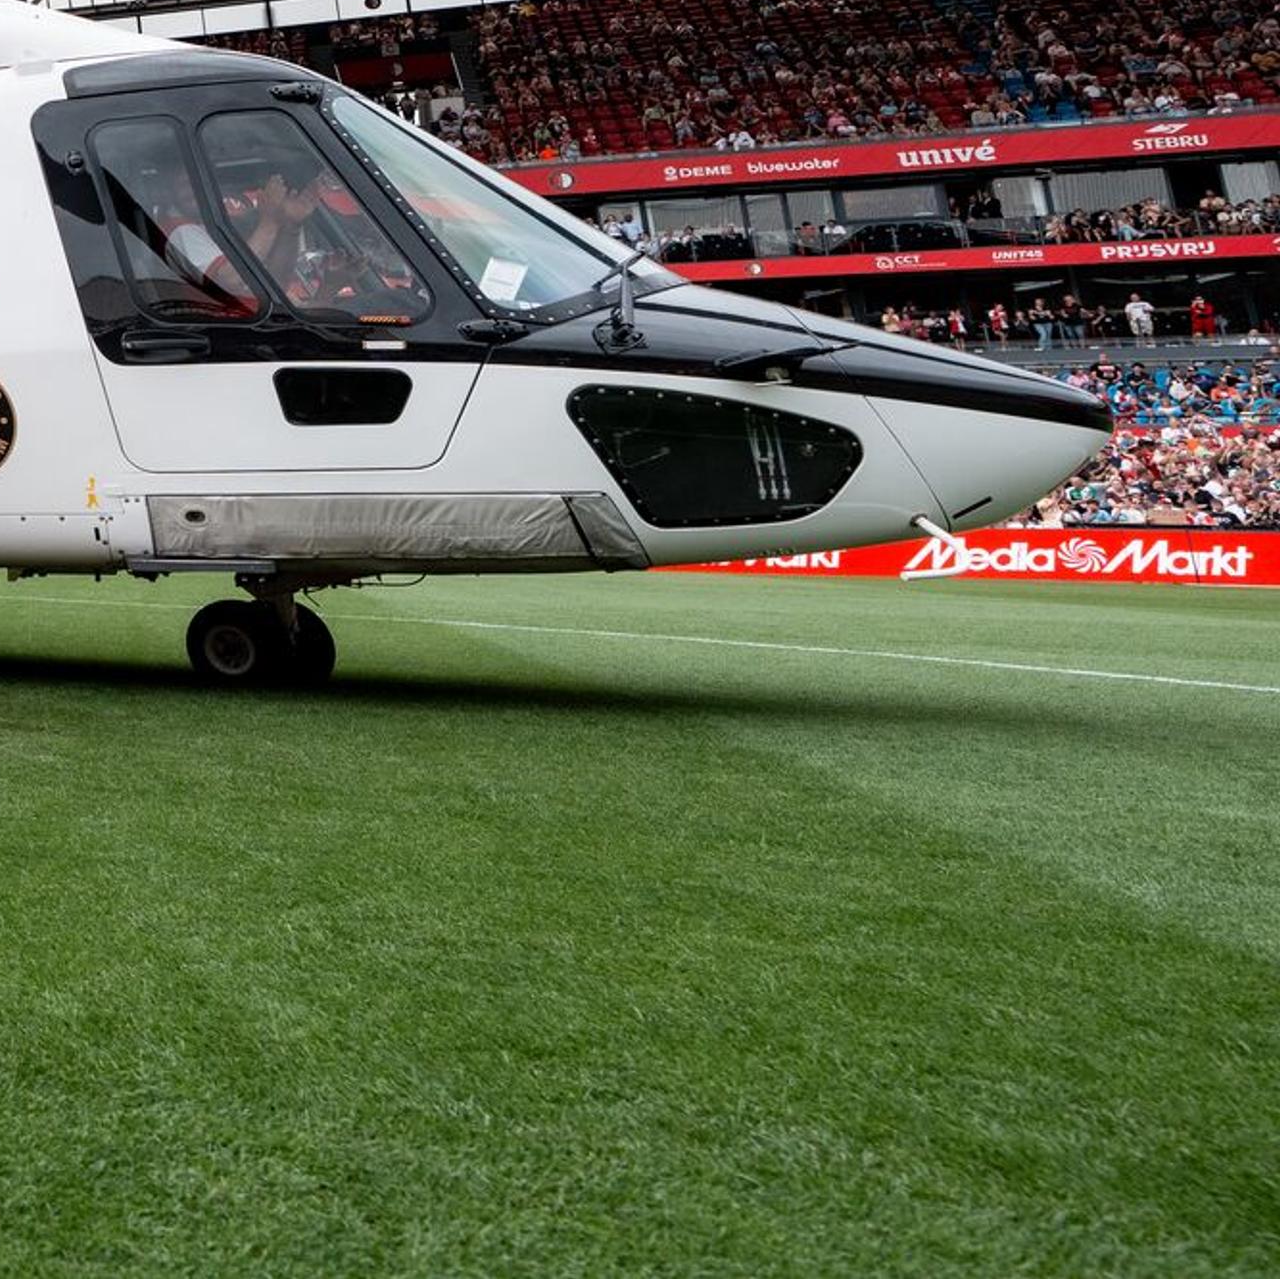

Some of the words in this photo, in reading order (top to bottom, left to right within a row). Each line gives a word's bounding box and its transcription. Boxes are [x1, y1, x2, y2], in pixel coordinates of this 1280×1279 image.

[1131, 134, 1209, 151] STEBRU
[896, 139, 997, 167] univé
[679, 164, 733, 178] DEME
[746, 158, 841, 174] bluewater
[906, 537, 1057, 573] Media
[1101, 538, 1254, 577] Markt
